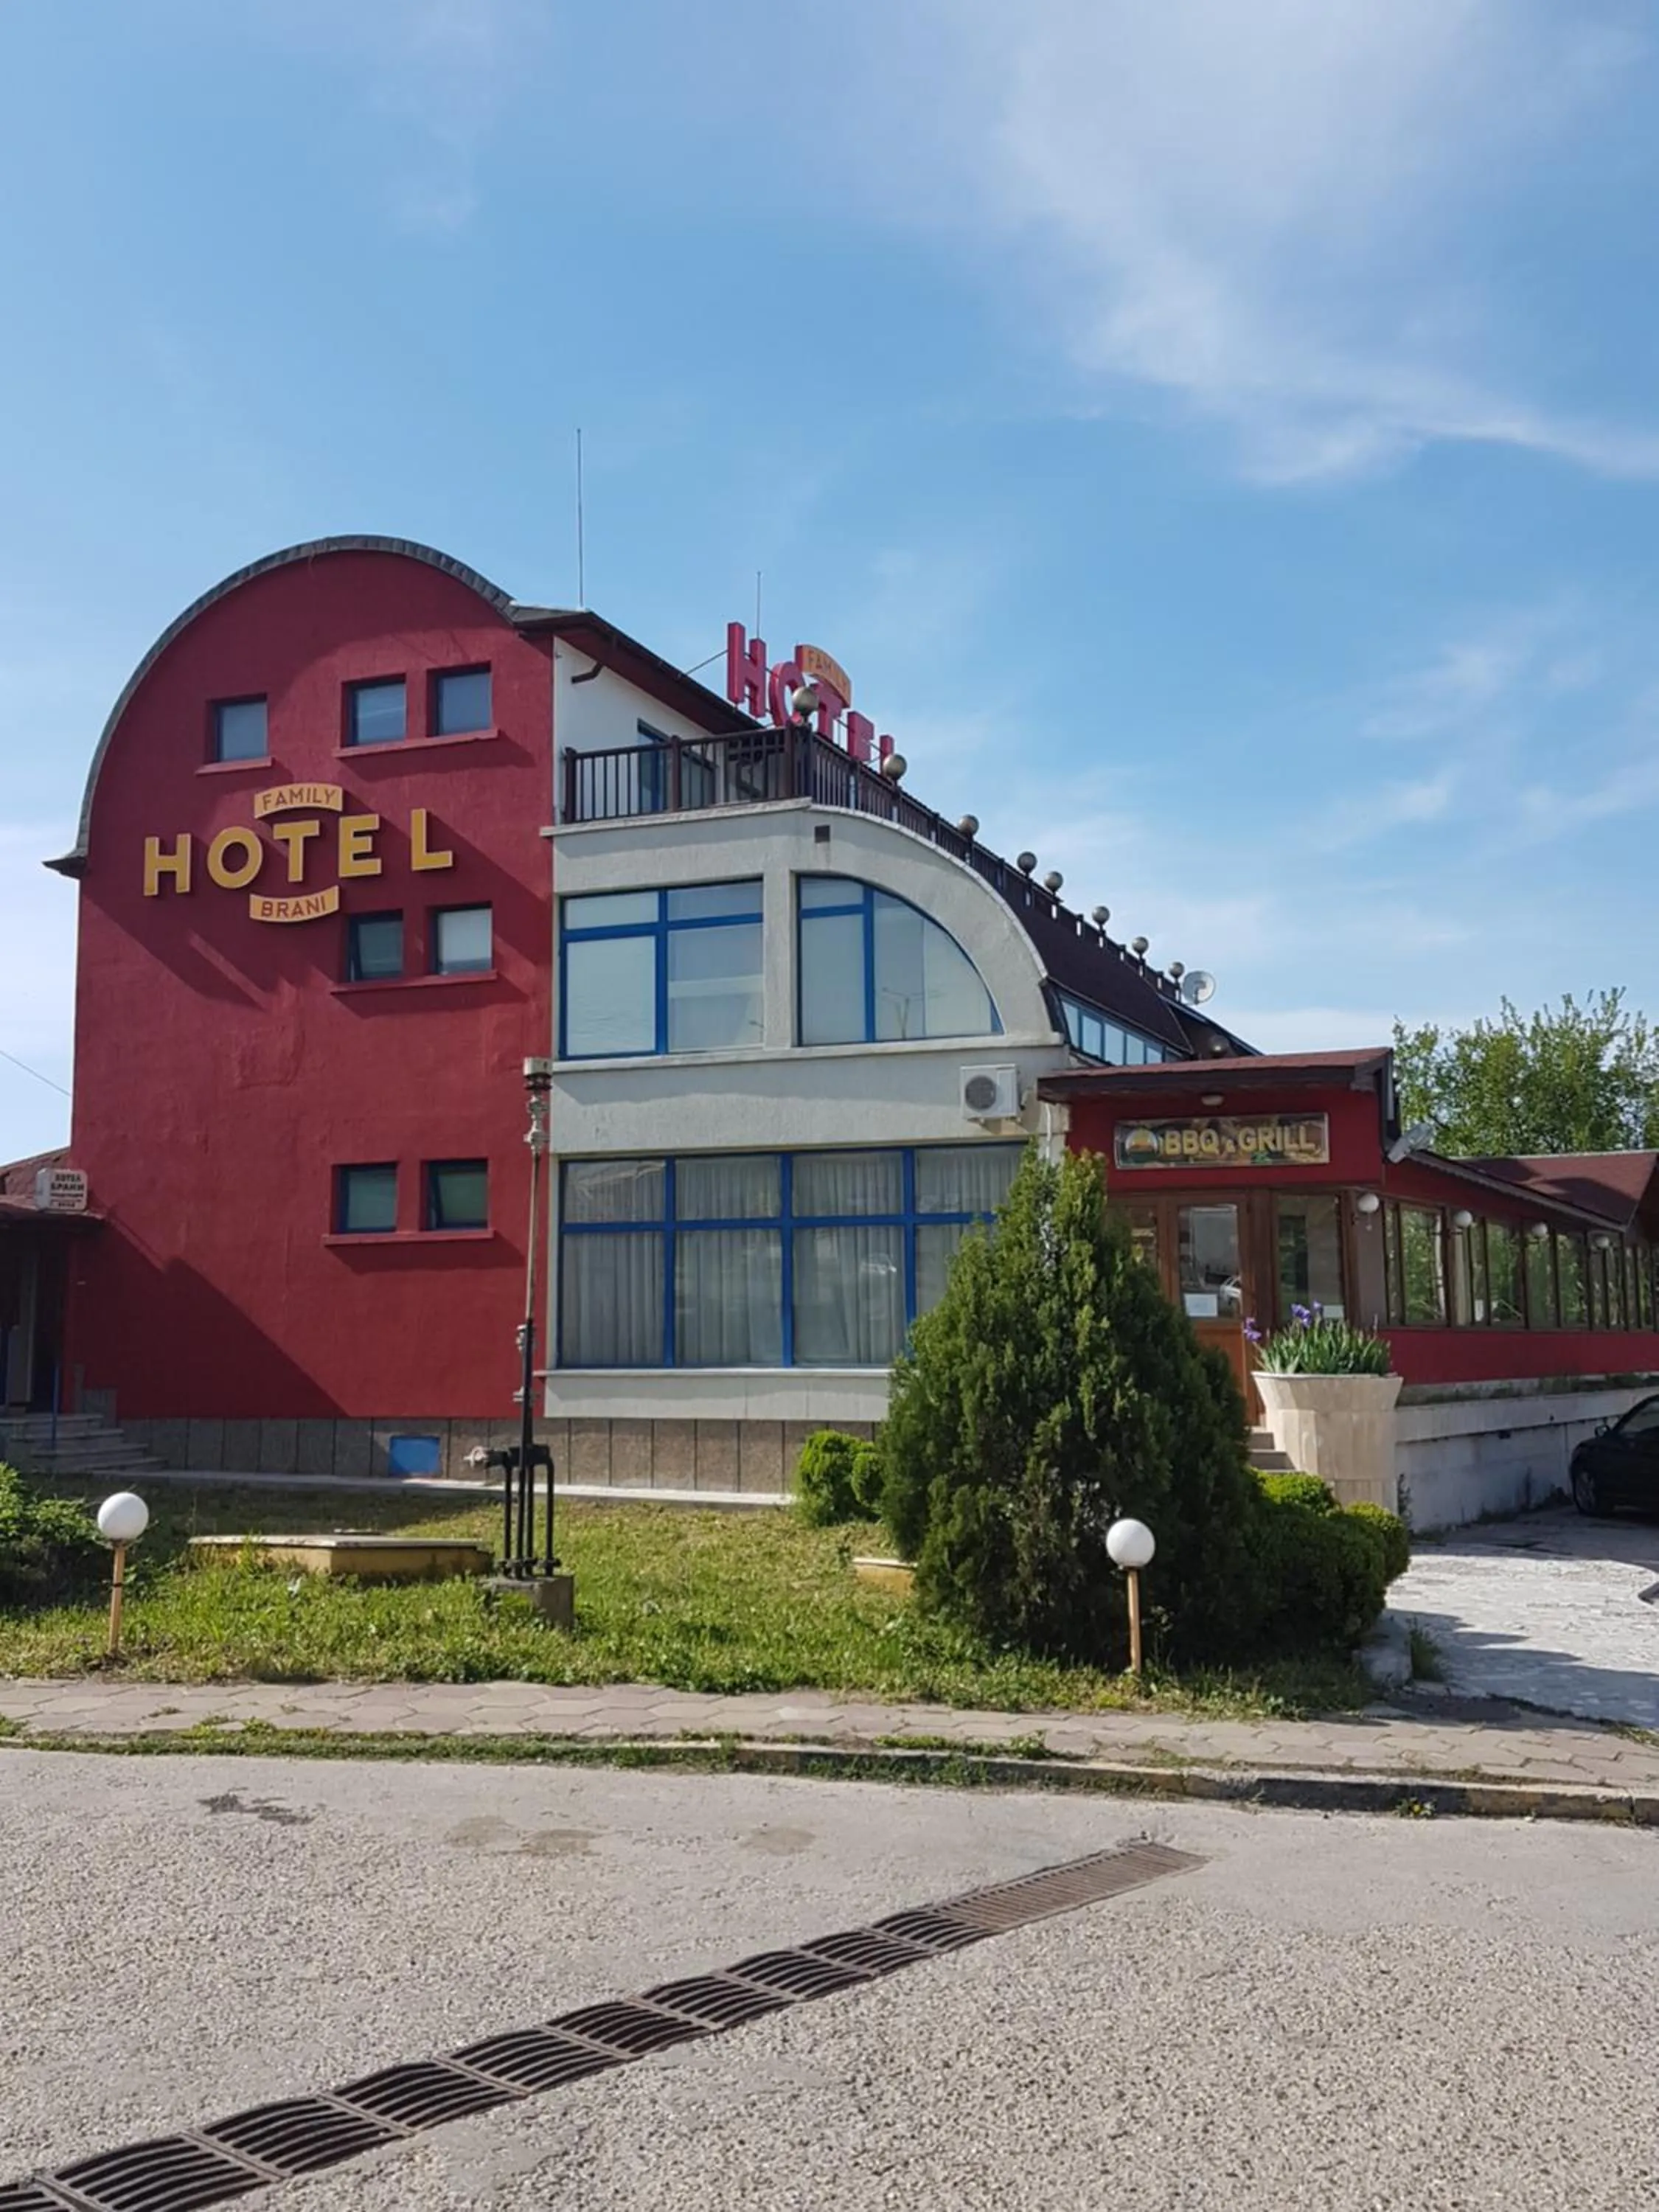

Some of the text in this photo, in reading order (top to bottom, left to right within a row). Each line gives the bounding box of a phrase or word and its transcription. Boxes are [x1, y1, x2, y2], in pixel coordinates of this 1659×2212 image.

[262, 787, 336, 810] FAMILY
[144, 808, 453, 896] HOTEL
[260, 897, 327, 917] BRANI
[1165, 1128, 1220, 1155] BBQ
[1238, 1125, 1315, 1152] GRILL
